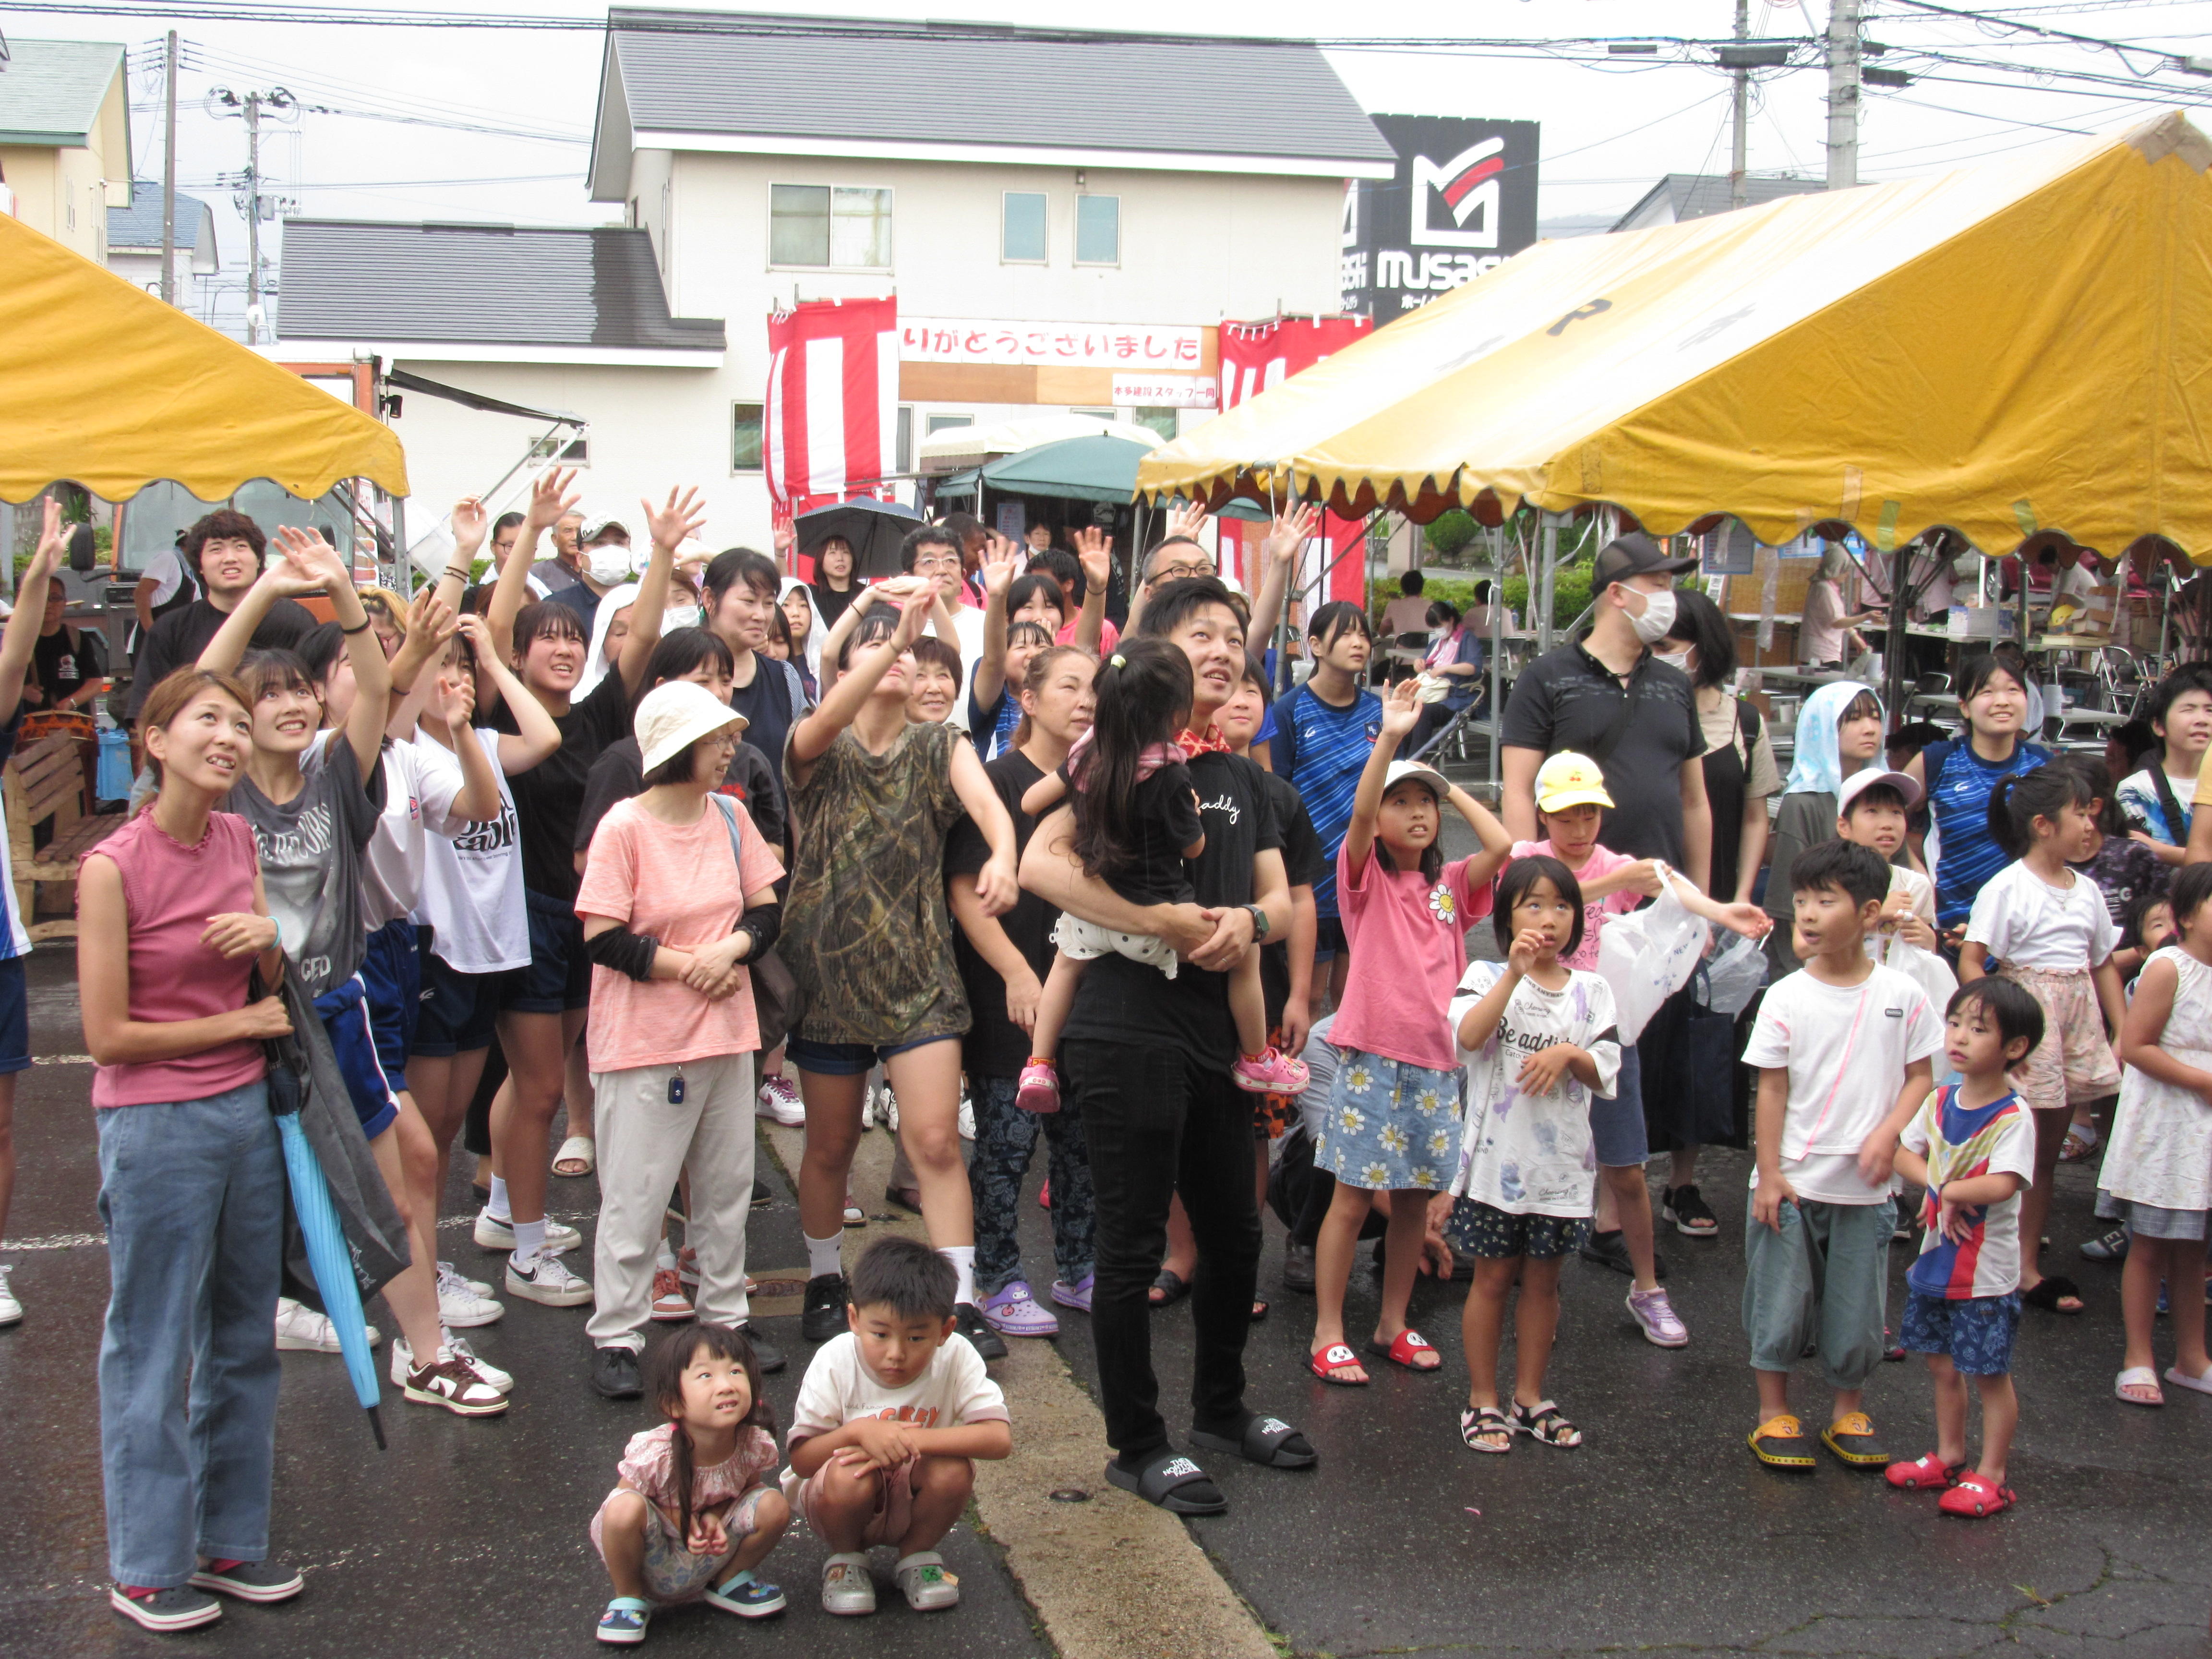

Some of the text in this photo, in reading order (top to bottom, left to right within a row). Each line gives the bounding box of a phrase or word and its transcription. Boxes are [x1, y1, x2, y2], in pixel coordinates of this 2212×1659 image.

[904, 327, 1198, 361] りがとうございました
[1198, 794, 1240, 825] addy
[867, 1406, 940, 1429] CKEY
[1163, 1462, 1190, 1476] NORTH
[1170, 1458, 1186, 1466] THE
